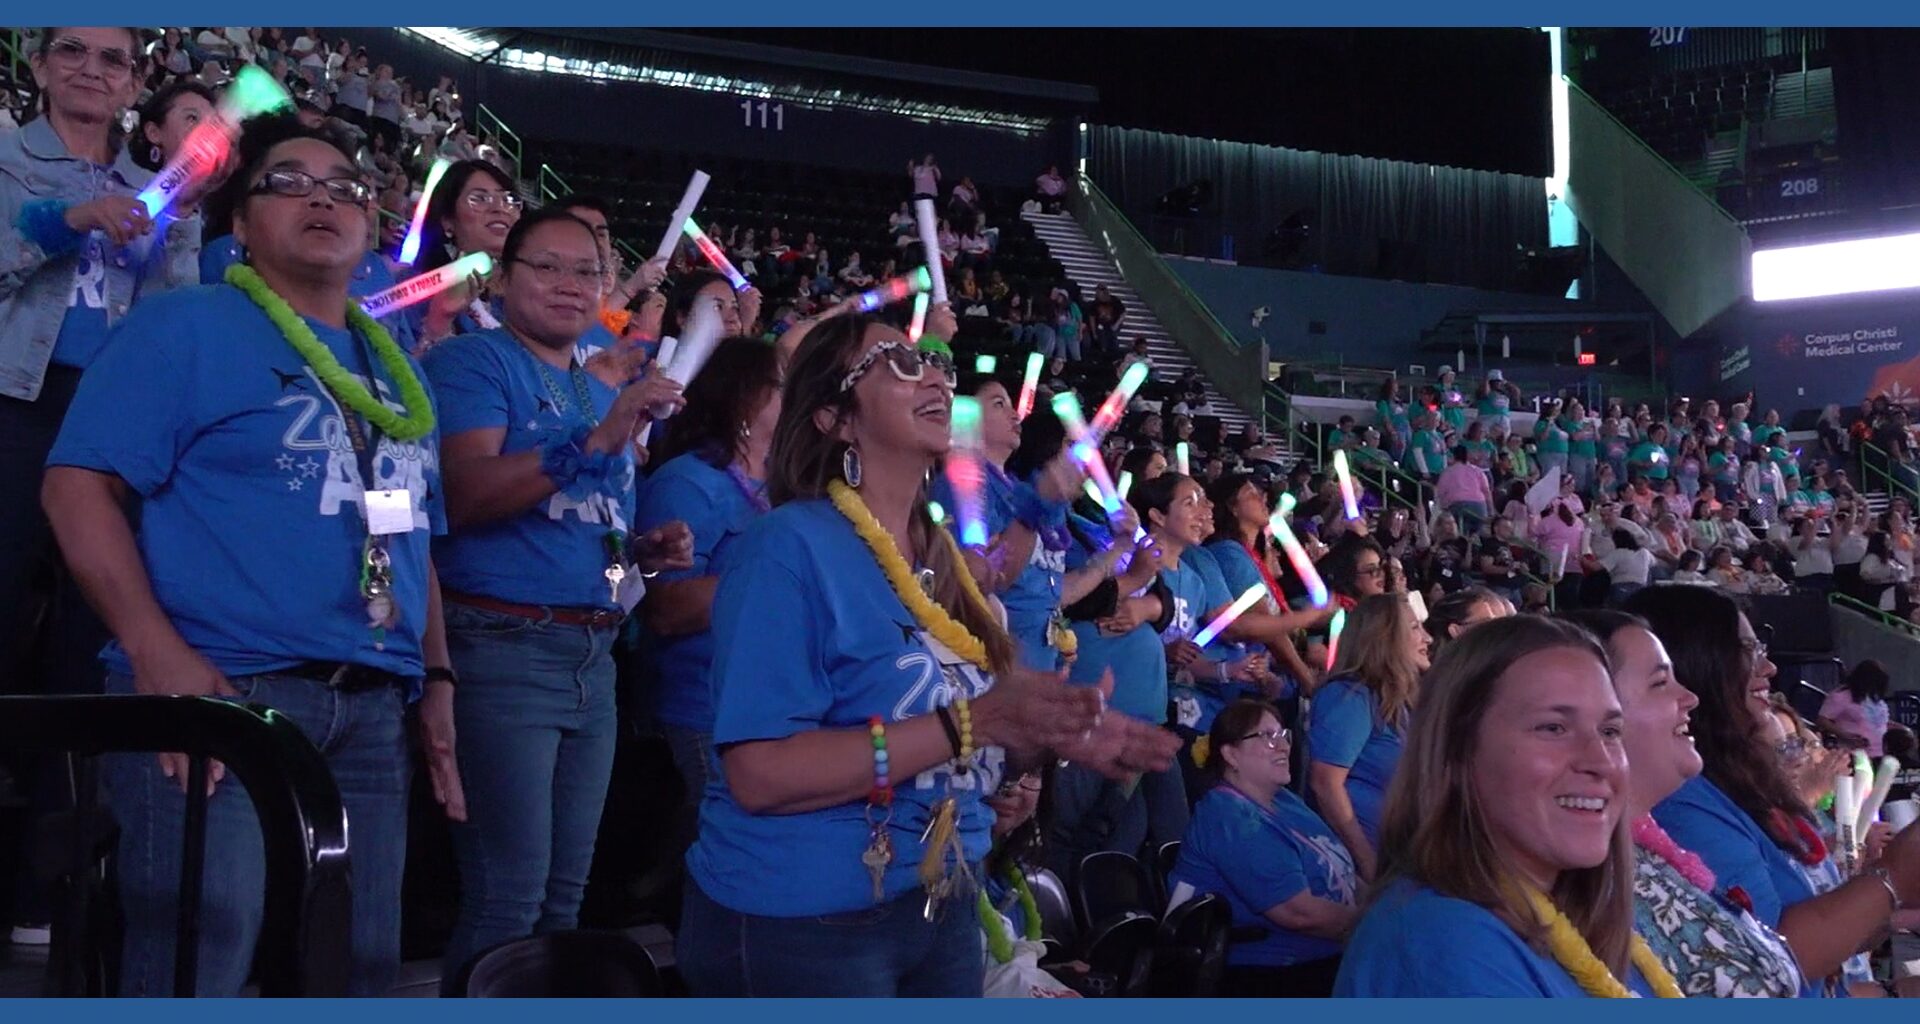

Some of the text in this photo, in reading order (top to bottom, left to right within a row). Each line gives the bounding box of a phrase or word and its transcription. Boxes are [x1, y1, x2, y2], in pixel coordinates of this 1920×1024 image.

[741, 100, 783, 130] 111
[1781, 178, 1818, 197] 208
[1805, 327, 1897, 345] Corpus Christi
[1805, 342, 1903, 357] Medical Center
